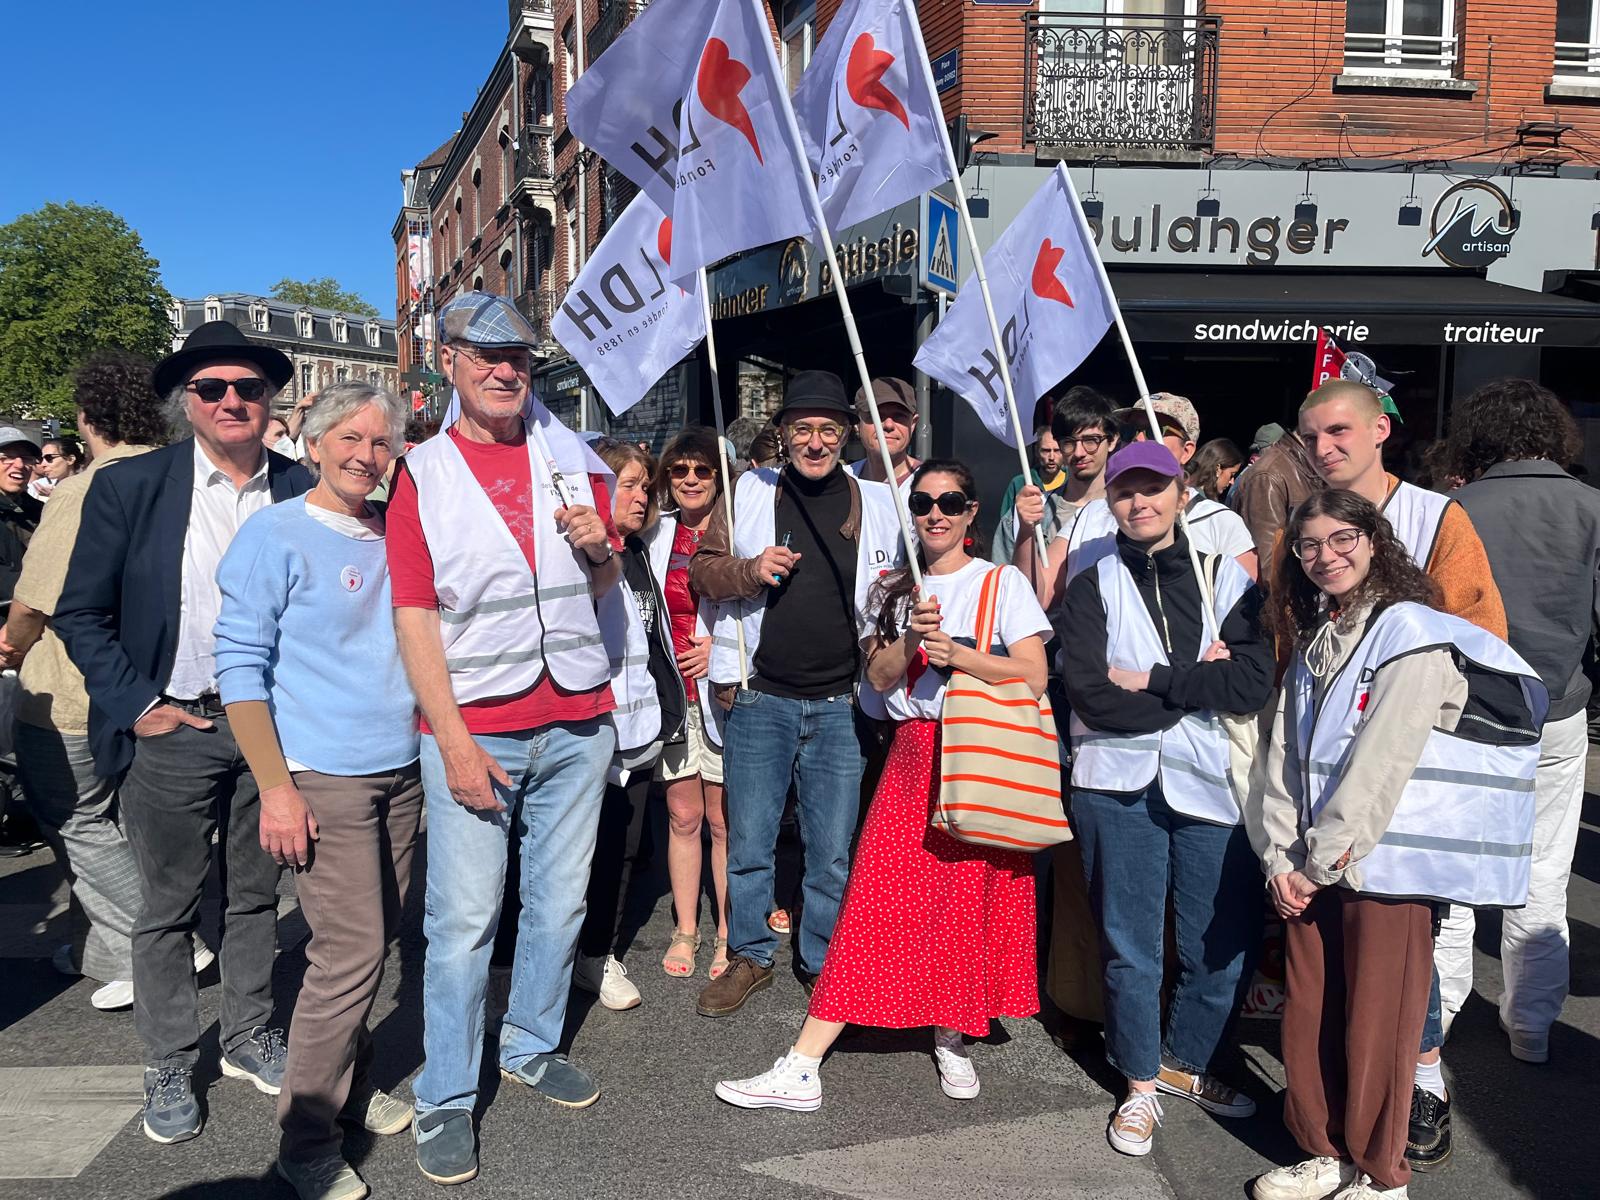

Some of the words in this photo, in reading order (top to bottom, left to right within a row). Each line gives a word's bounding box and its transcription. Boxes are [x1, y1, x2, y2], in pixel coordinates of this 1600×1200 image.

[1085, 203, 1350, 266] ulanger
[1461, 240, 1511, 253] artisan
[819, 222, 919, 295] pâtissie
[1443, 321, 1545, 343] traiteur
